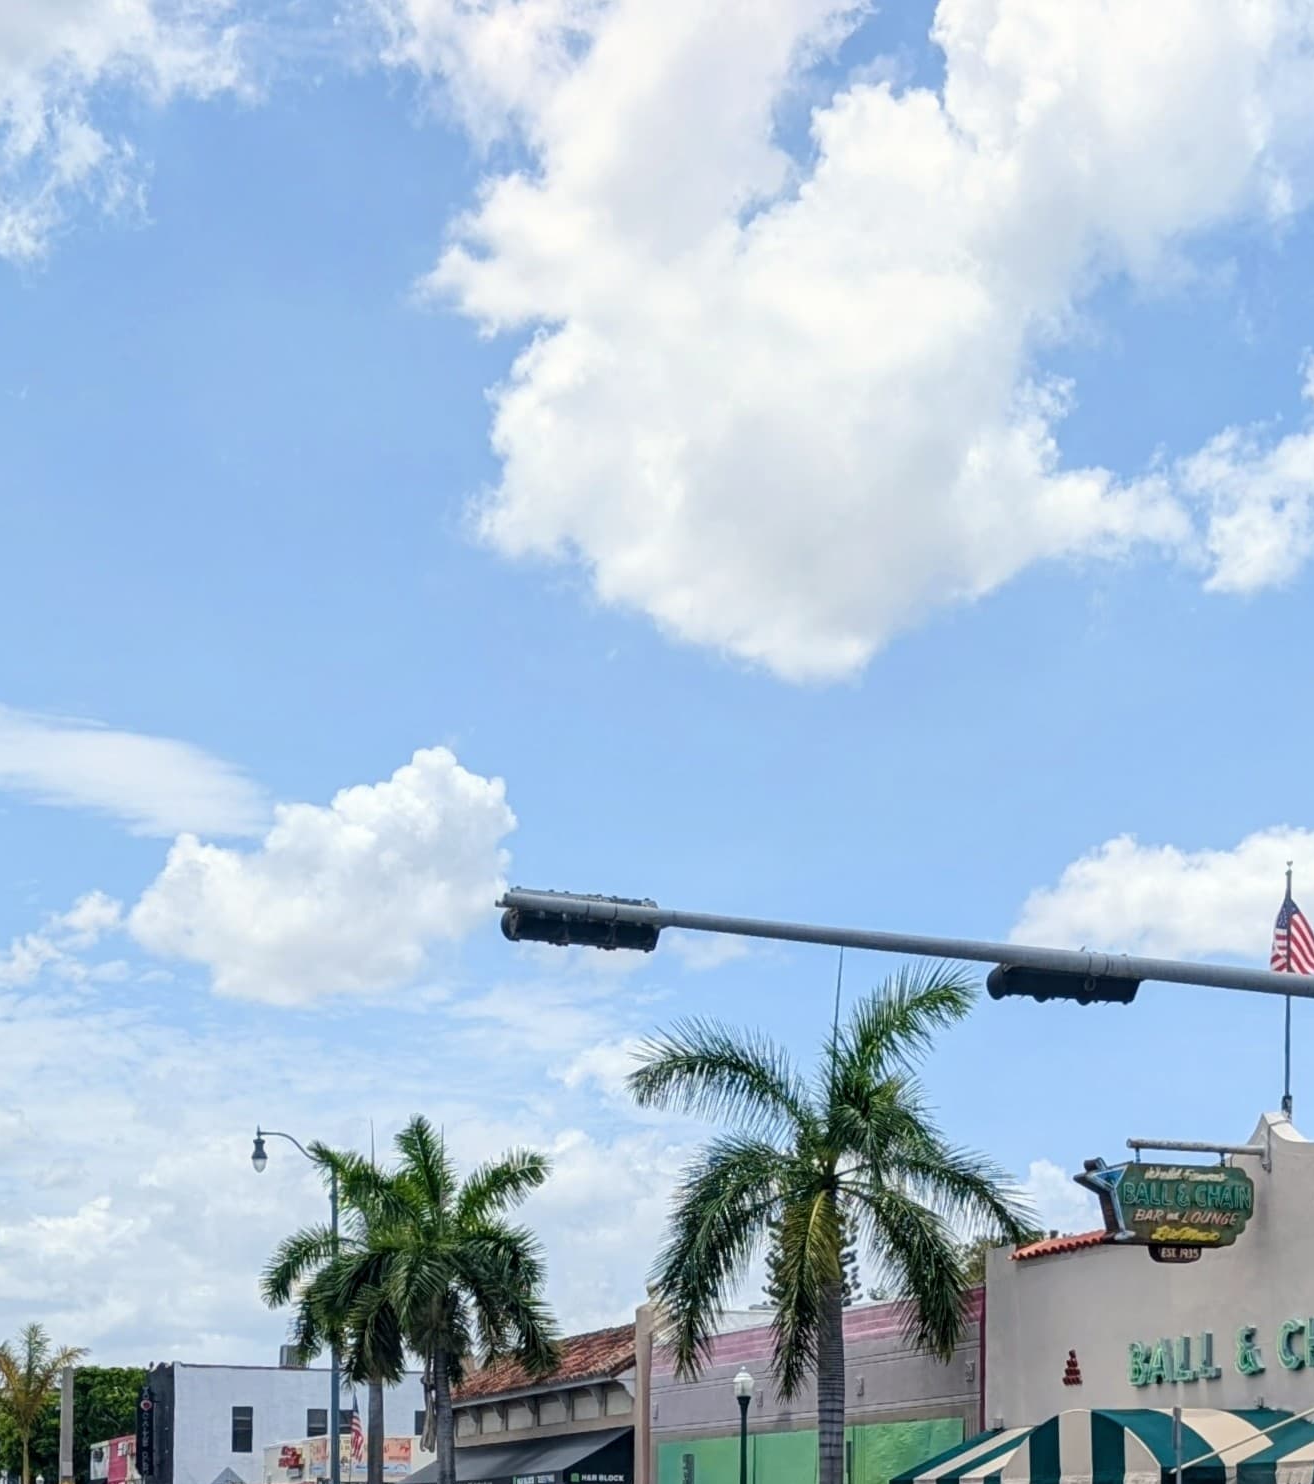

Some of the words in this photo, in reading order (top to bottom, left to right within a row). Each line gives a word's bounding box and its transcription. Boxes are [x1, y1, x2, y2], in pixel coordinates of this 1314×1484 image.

[1123, 1182, 1174, 1206] BALL
[1177, 1184, 1191, 1207] &
[1195, 1184, 1251, 1209] CHAIN
[1134, 1209, 1164, 1221] BAR
[1181, 1212, 1240, 1225] LOUNGE
[1128, 1330, 1222, 1387] BALL
[1235, 1325, 1265, 1376] &
[599, 1474, 625, 1482] BLOCK
